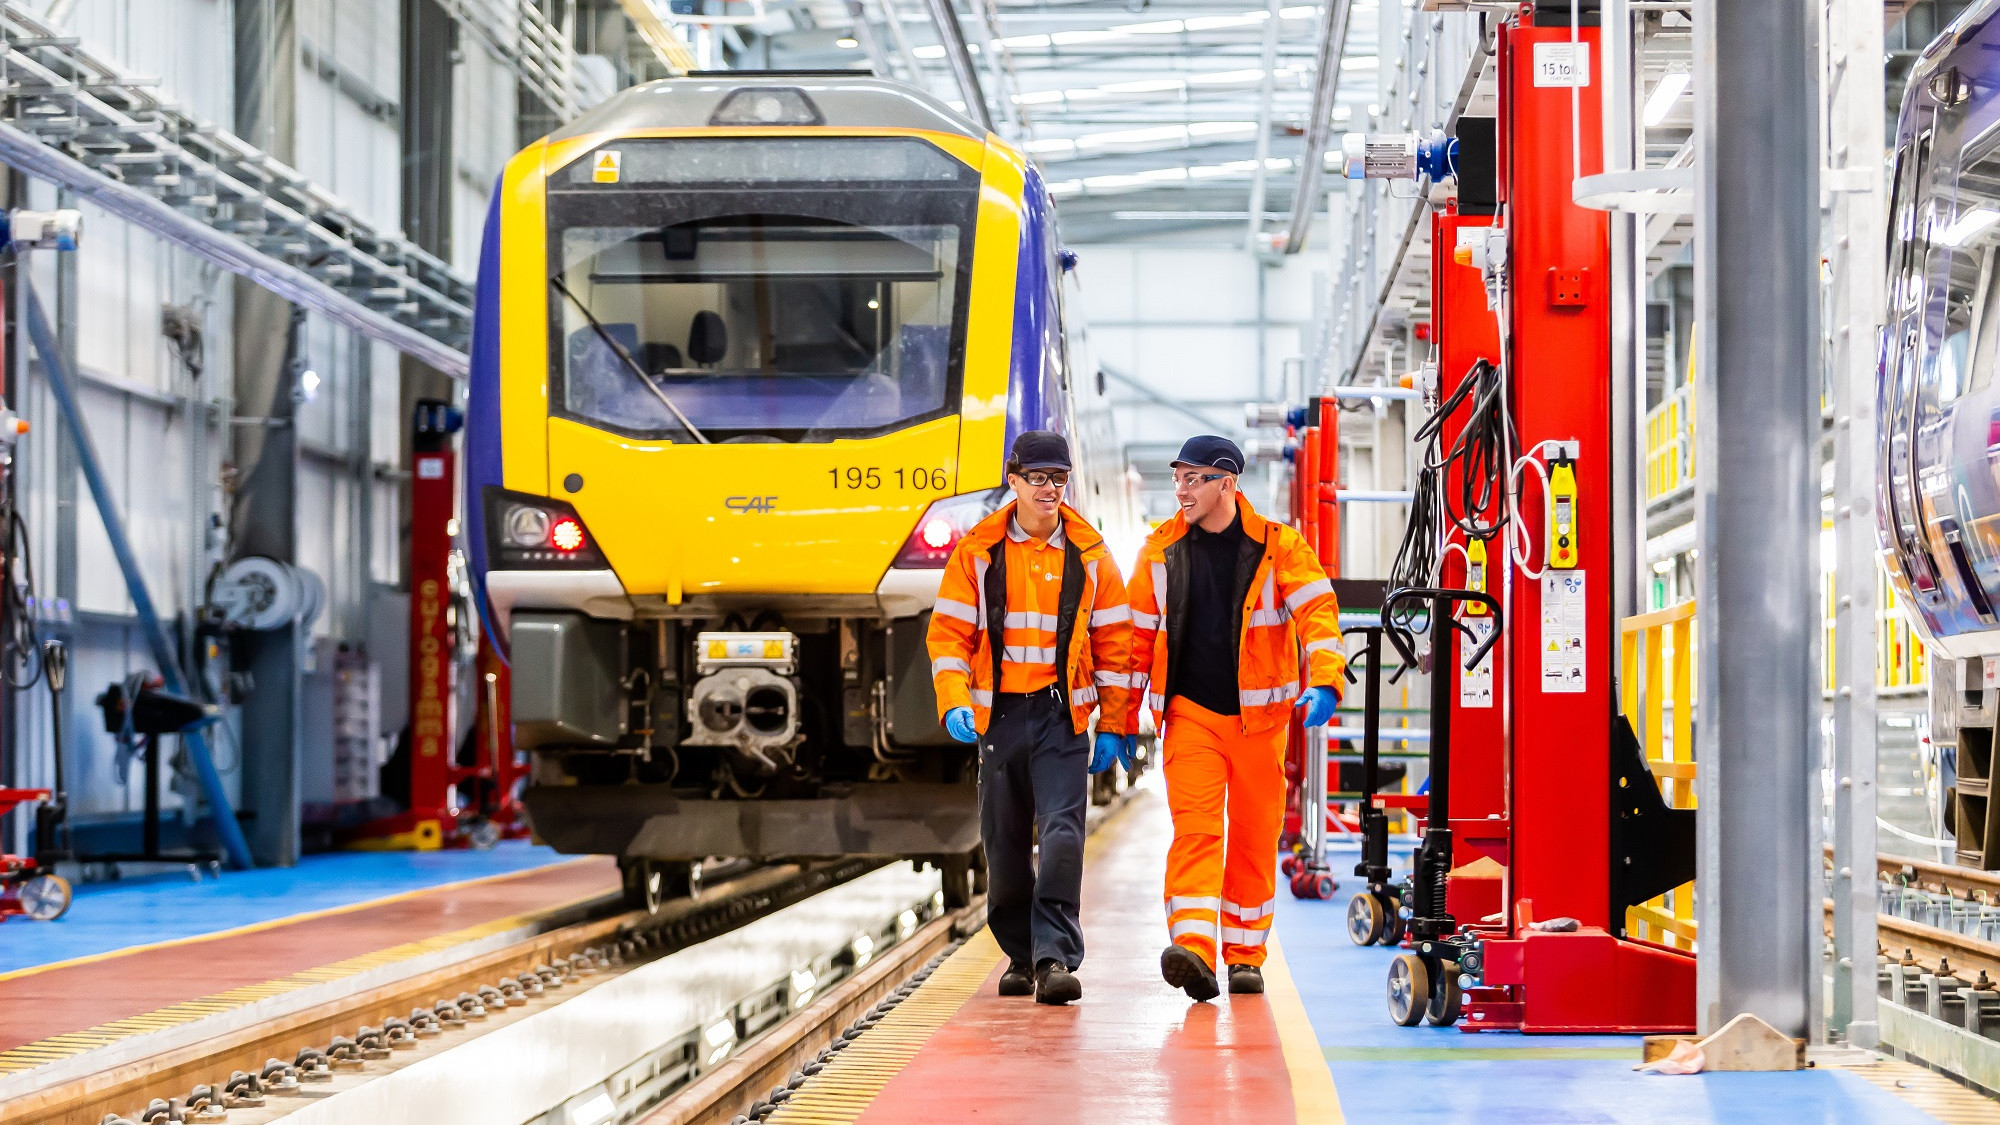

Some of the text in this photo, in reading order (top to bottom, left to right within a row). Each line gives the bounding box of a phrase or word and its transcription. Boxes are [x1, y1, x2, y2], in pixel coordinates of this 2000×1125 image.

[1542, 63, 1556, 75] 15
[828, 466, 947, 492] 195 106
[726, 497, 778, 514] CAF
